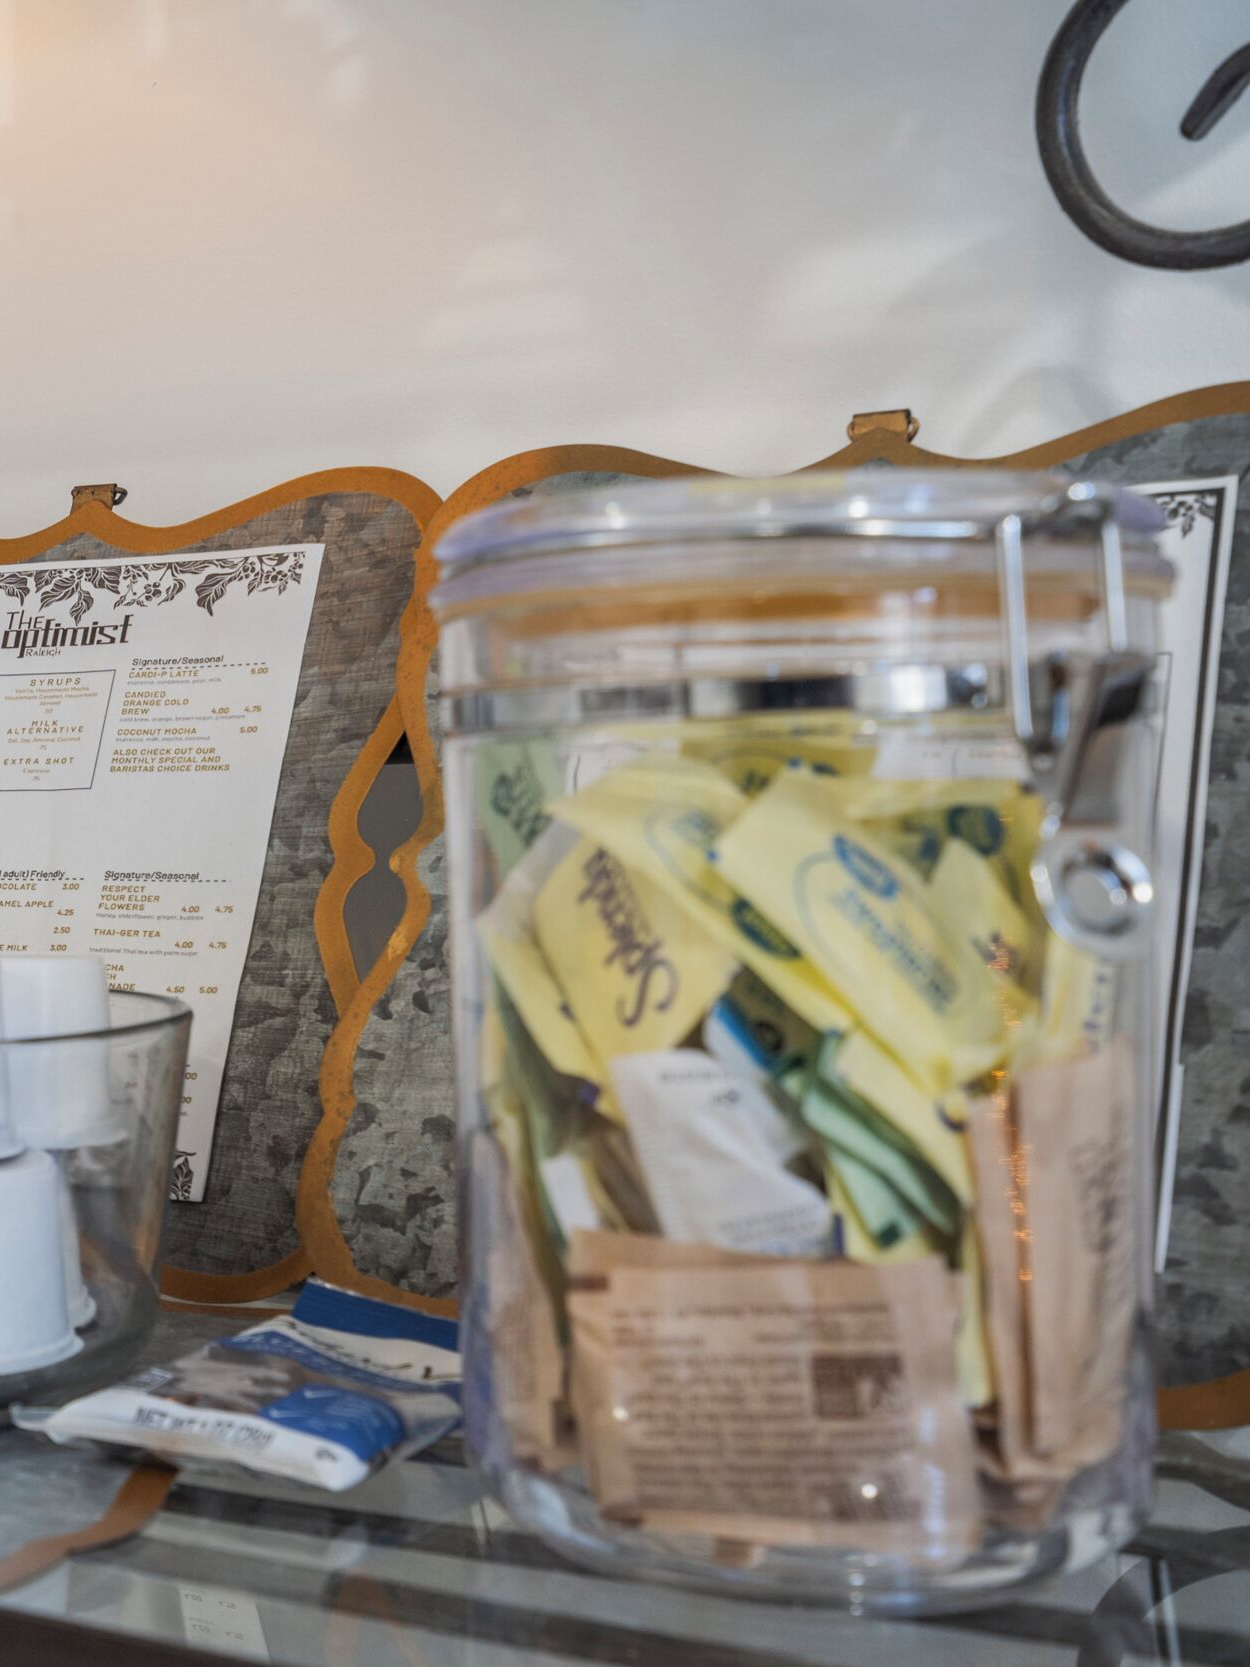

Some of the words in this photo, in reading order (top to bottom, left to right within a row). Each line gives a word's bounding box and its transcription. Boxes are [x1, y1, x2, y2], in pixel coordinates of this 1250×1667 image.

[7, 610, 44, 630] THE
[1, 614, 134, 658] optimist
[132, 655, 224, 667] Signature/Seasonal
[30, 678, 81, 686] SYRUPS
[7, 726, 84, 734] ALTERNATIVE
[3, 870, 29, 878] adult)
[30, 870, 65, 880] Friendly
[105, 871, 199, 880] Signature/Seasonal
